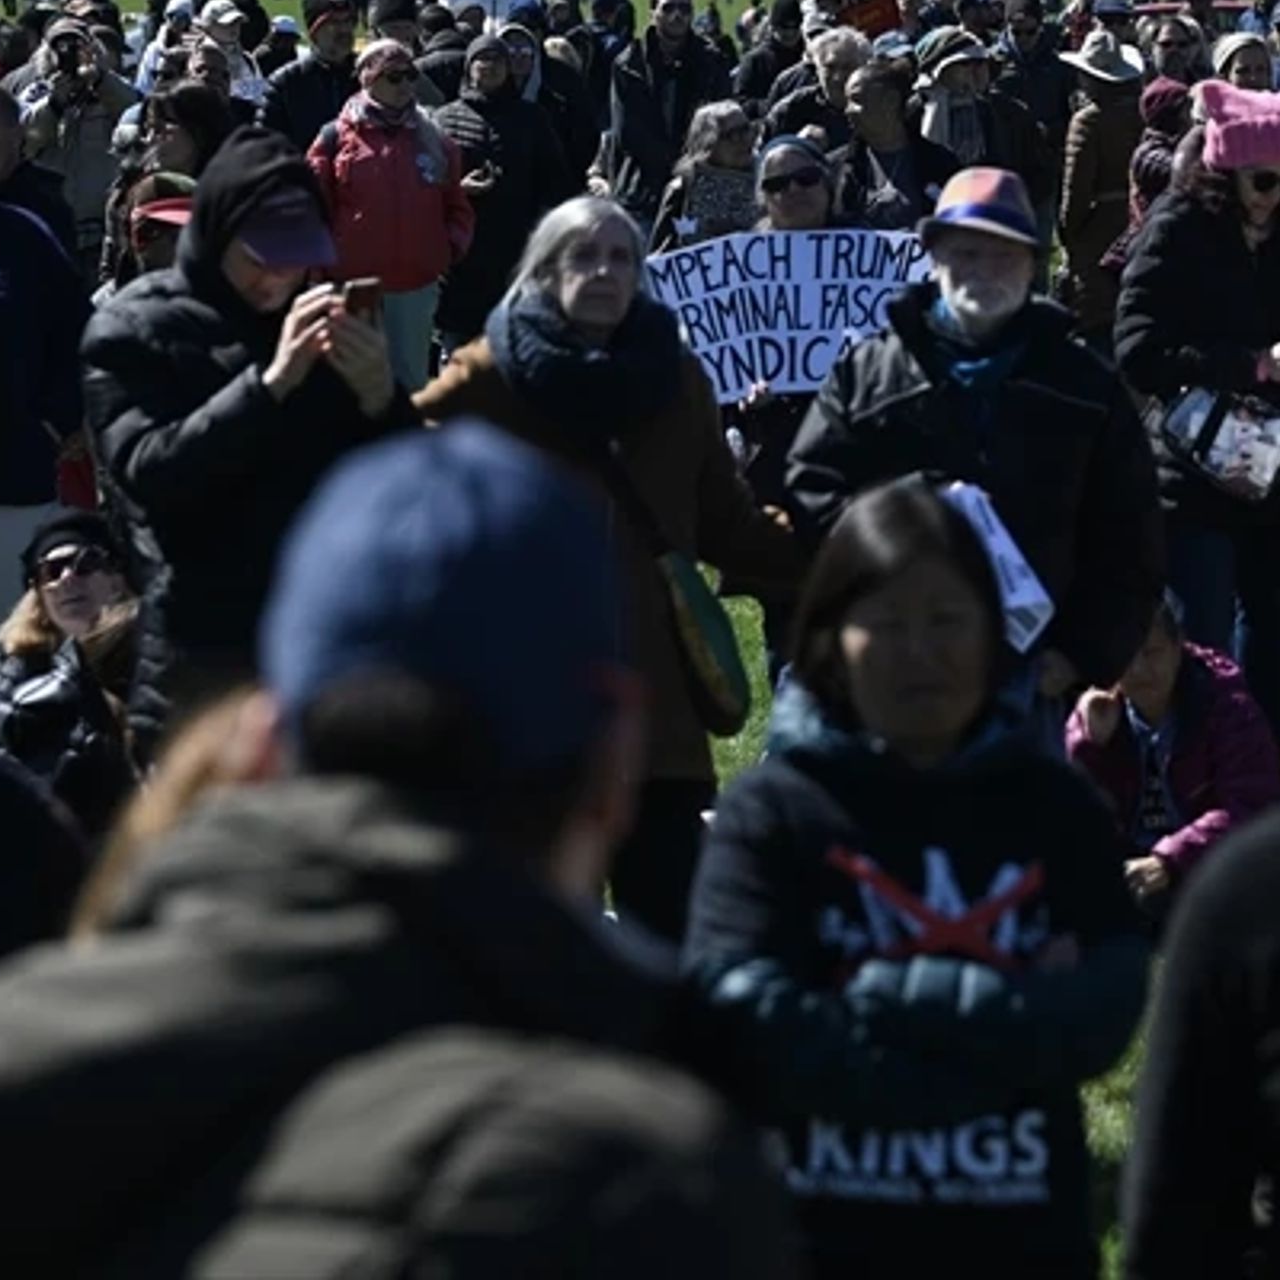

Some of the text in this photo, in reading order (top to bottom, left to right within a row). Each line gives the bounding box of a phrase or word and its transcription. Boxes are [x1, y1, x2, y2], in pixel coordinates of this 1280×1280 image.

[646, 233, 928, 300] MPEACH TRUMP
[679, 284, 893, 349] RIMINAL FASC
[701, 335, 854, 393] YNDIC
